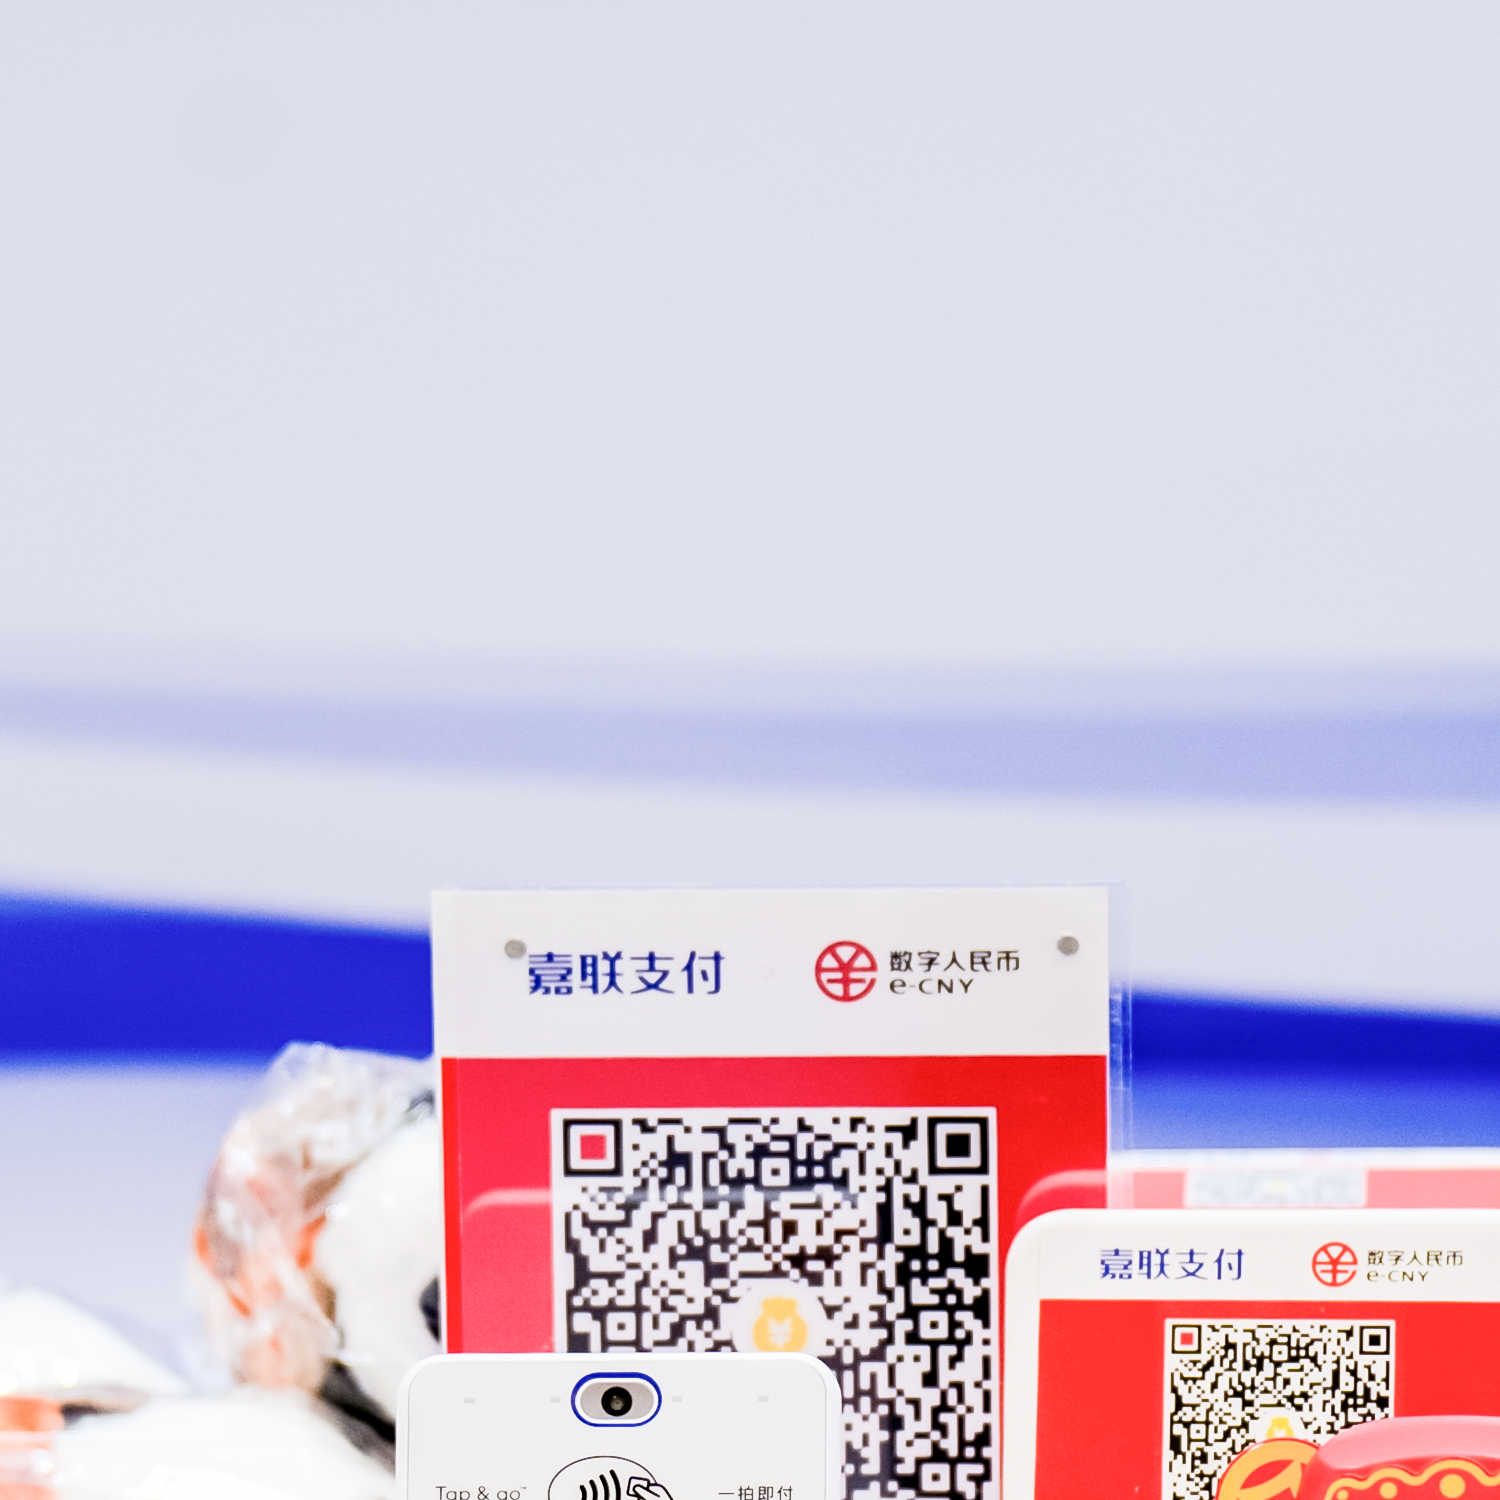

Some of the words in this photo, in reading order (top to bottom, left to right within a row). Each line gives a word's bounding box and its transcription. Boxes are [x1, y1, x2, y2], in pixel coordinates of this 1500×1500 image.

[889, 949, 1021, 974] 数字人民币
[527, 951, 725, 996] 嘉联支付
[889, 977, 975, 995] e-CNY
[1100, 1248, 1246, 1281] 嘉联支付
[1366, 1249, 1464, 1268] 数字人民币
[1366, 1269, 1429, 1283] e-CNY
[477, 1486, 490, 1500] &
